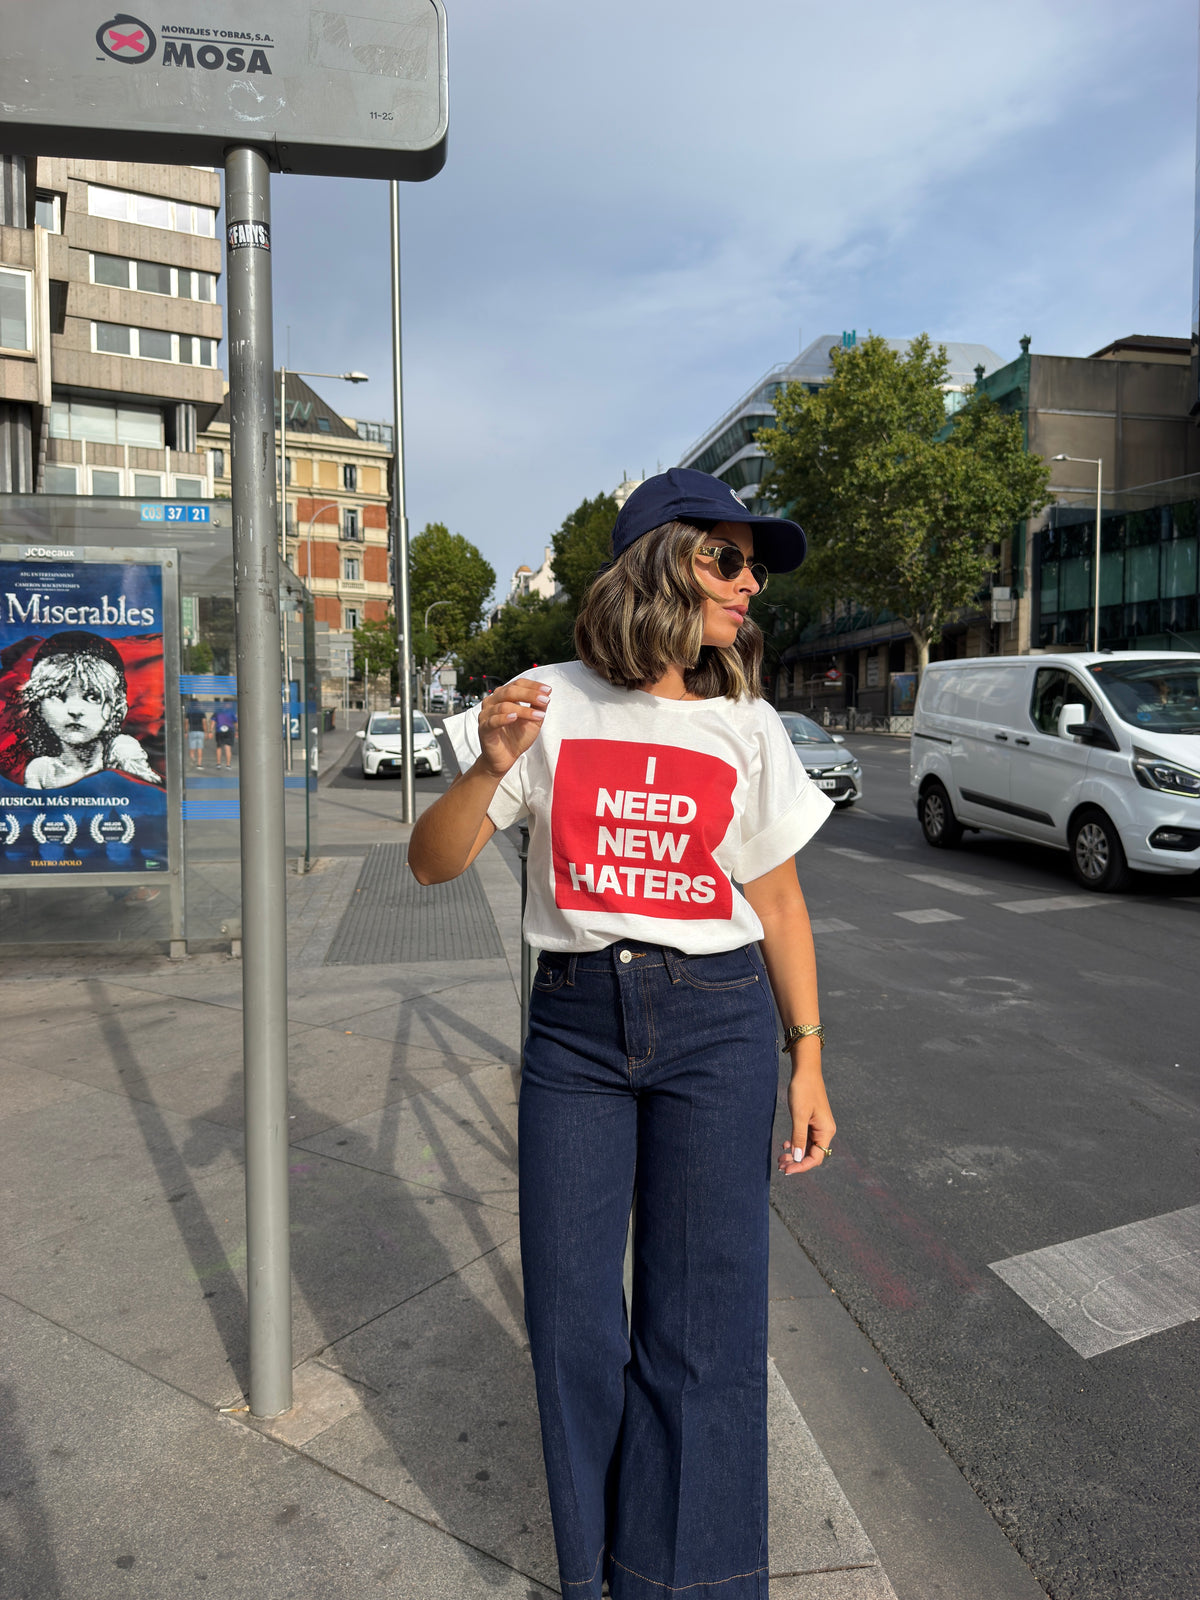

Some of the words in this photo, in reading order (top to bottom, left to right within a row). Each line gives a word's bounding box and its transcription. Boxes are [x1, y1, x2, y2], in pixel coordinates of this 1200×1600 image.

[161, 25, 210, 36] MONTAJES
[212, 29, 219, 37] Y
[162, 41, 273, 75] MOSA
[142, 507, 162, 519] C03
[167, 507, 183, 520] 37
[192, 508, 206, 521] 21
[25, 547, 75, 557] JCDecaux
[5, 592, 155, 626] Miserables
[645, 756, 657, 785] I
[46, 795, 70, 806] MÁS
[71, 796, 130, 806] PREMIADO
[595, 787, 697, 825] NEED
[597, 825, 691, 864] NEW
[568, 862, 717, 904] HATERS
